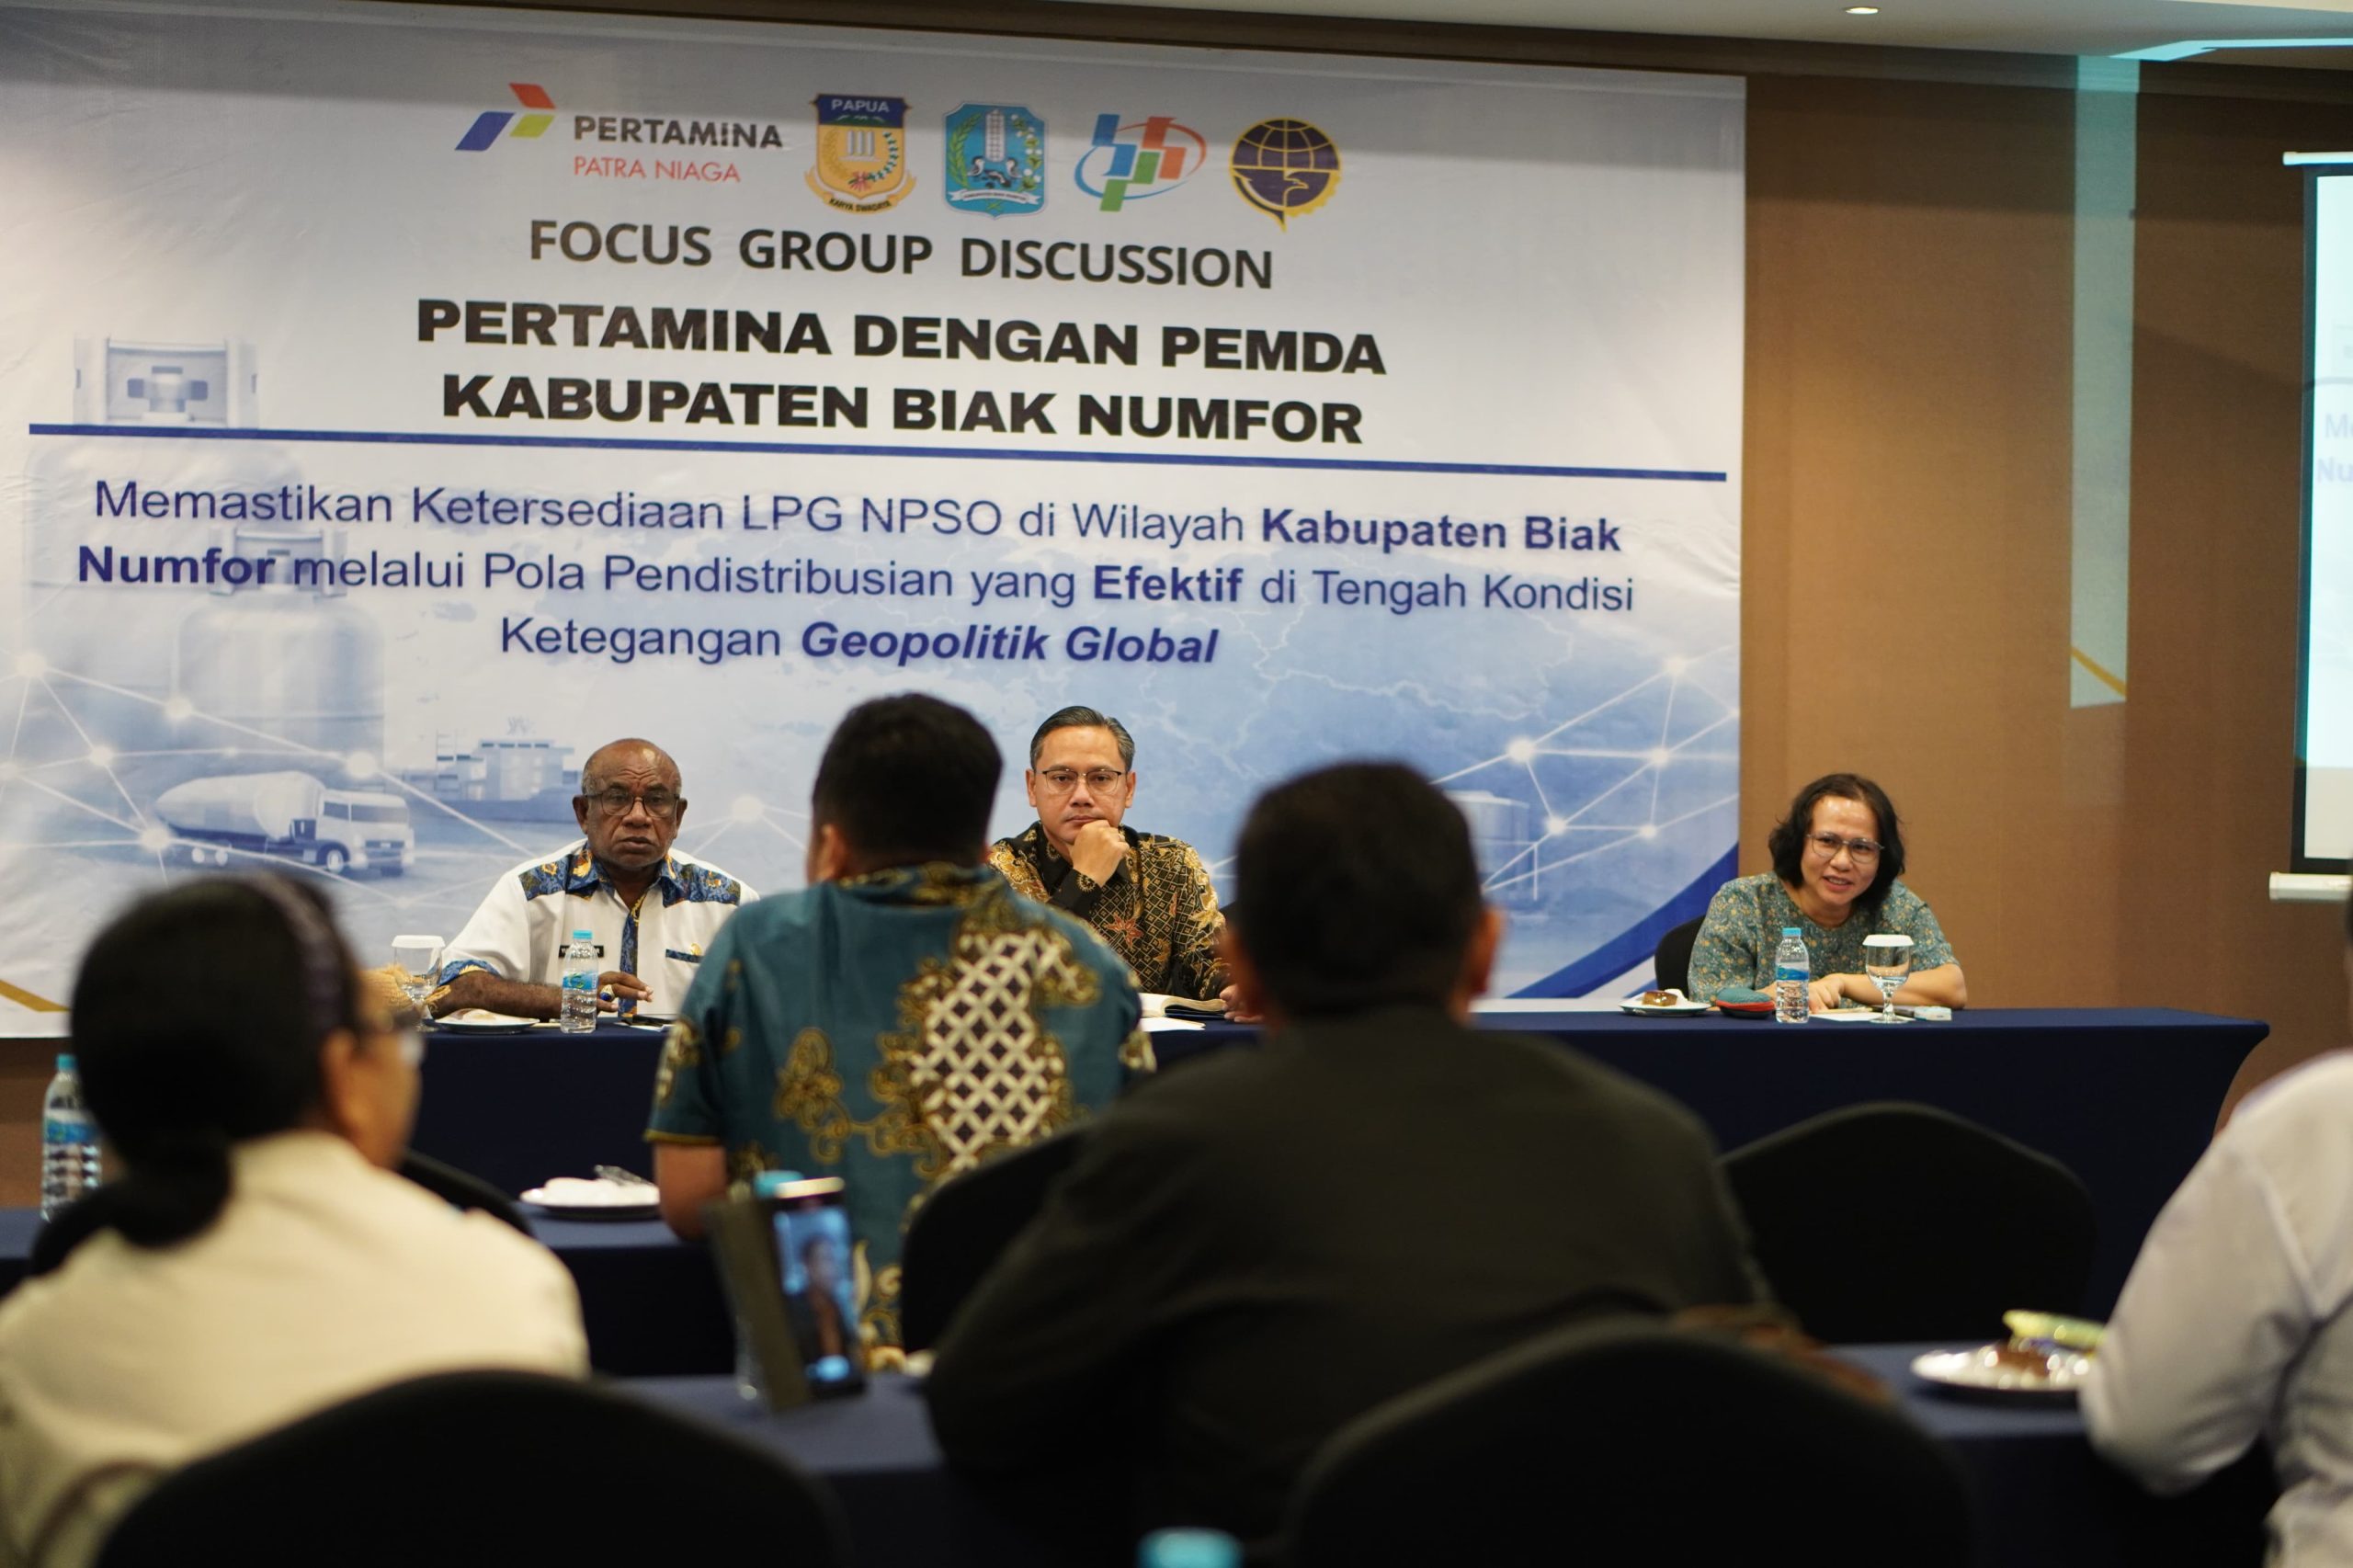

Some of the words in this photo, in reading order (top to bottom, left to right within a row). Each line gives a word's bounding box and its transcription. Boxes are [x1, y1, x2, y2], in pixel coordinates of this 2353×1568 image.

[831, 98, 890, 113] PAPUA
[574, 155, 646, 178] PATRA
[655, 160, 741, 182] NIAGA
[531, 221, 711, 266] FOCUS
[740, 229, 932, 274] GROUP
[962, 238, 1271, 289] DISCUSSION
[418, 300, 832, 355] PERTAMINA
[855, 315, 1137, 365] DENGAN
[1163, 326, 1386, 374] PEMDA
[444, 374, 868, 428] KABUPATEN
[893, 389, 1056, 434] BIAK
[1079, 394, 1361, 443] NUMFOR
[97, 481, 392, 522] Memastikan
[414, 487, 722, 529] Ketersediaan
[744, 494, 842, 531] LPG
[863, 497, 1001, 536] NPSO
[1019, 503, 1054, 536] di
[1073, 504, 1243, 549] Wilayah
[1263, 508, 1506, 554] Kabupaten
[1525, 516, 1620, 551] Biak
[79, 546, 276, 585] Numfor
[294, 551, 463, 587] melalui
[485, 552, 584, 589] Pola
[605, 555, 952, 596] Pendistribusian
[971, 572, 1074, 608] yang
[1095, 565, 1244, 602] Efektif
[1261, 570, 1294, 603] di
[1312, 570, 1465, 615] Tengah
[1484, 574, 1632, 611] Kondisi
[503, 618, 779, 665] Ketegangan
[802, 621, 1050, 666] Geopolitik
[1065, 626, 1219, 663] Global
